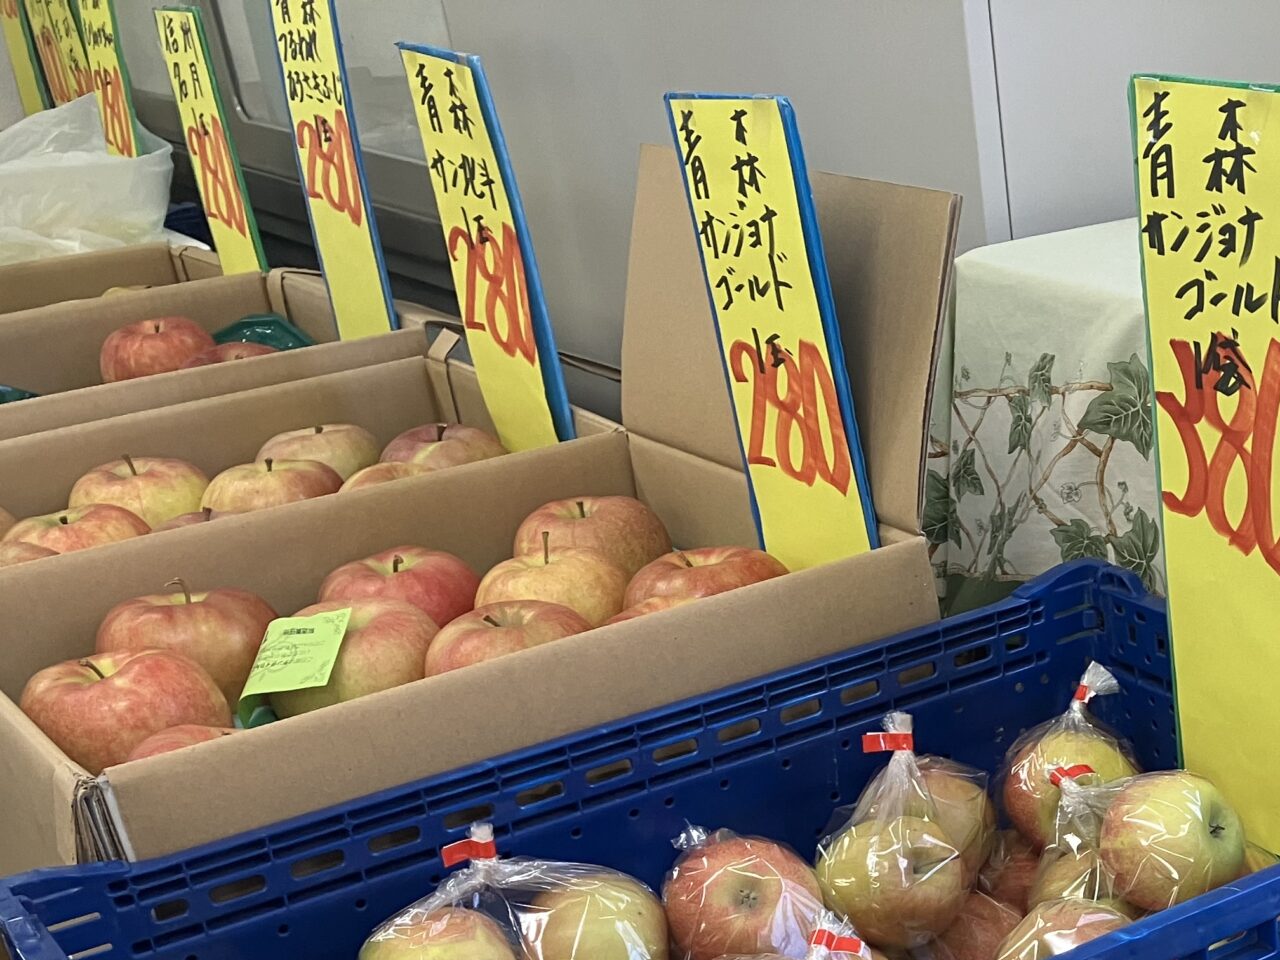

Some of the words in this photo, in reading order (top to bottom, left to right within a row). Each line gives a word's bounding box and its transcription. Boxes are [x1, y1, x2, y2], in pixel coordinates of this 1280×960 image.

[163, 15, 199, 63] 信州
[173, 62, 204, 103] 名月
[415, 62, 477, 141] 青森
[1142, 90, 1258, 200] 青森
[187, 112, 248, 239] 280
[296, 108, 363, 228] 280
[679, 109, 767, 200] 青森
[447, 221, 537, 368] 280
[714, 252, 794, 312] ゴールド
[729, 337, 852, 498] 280
